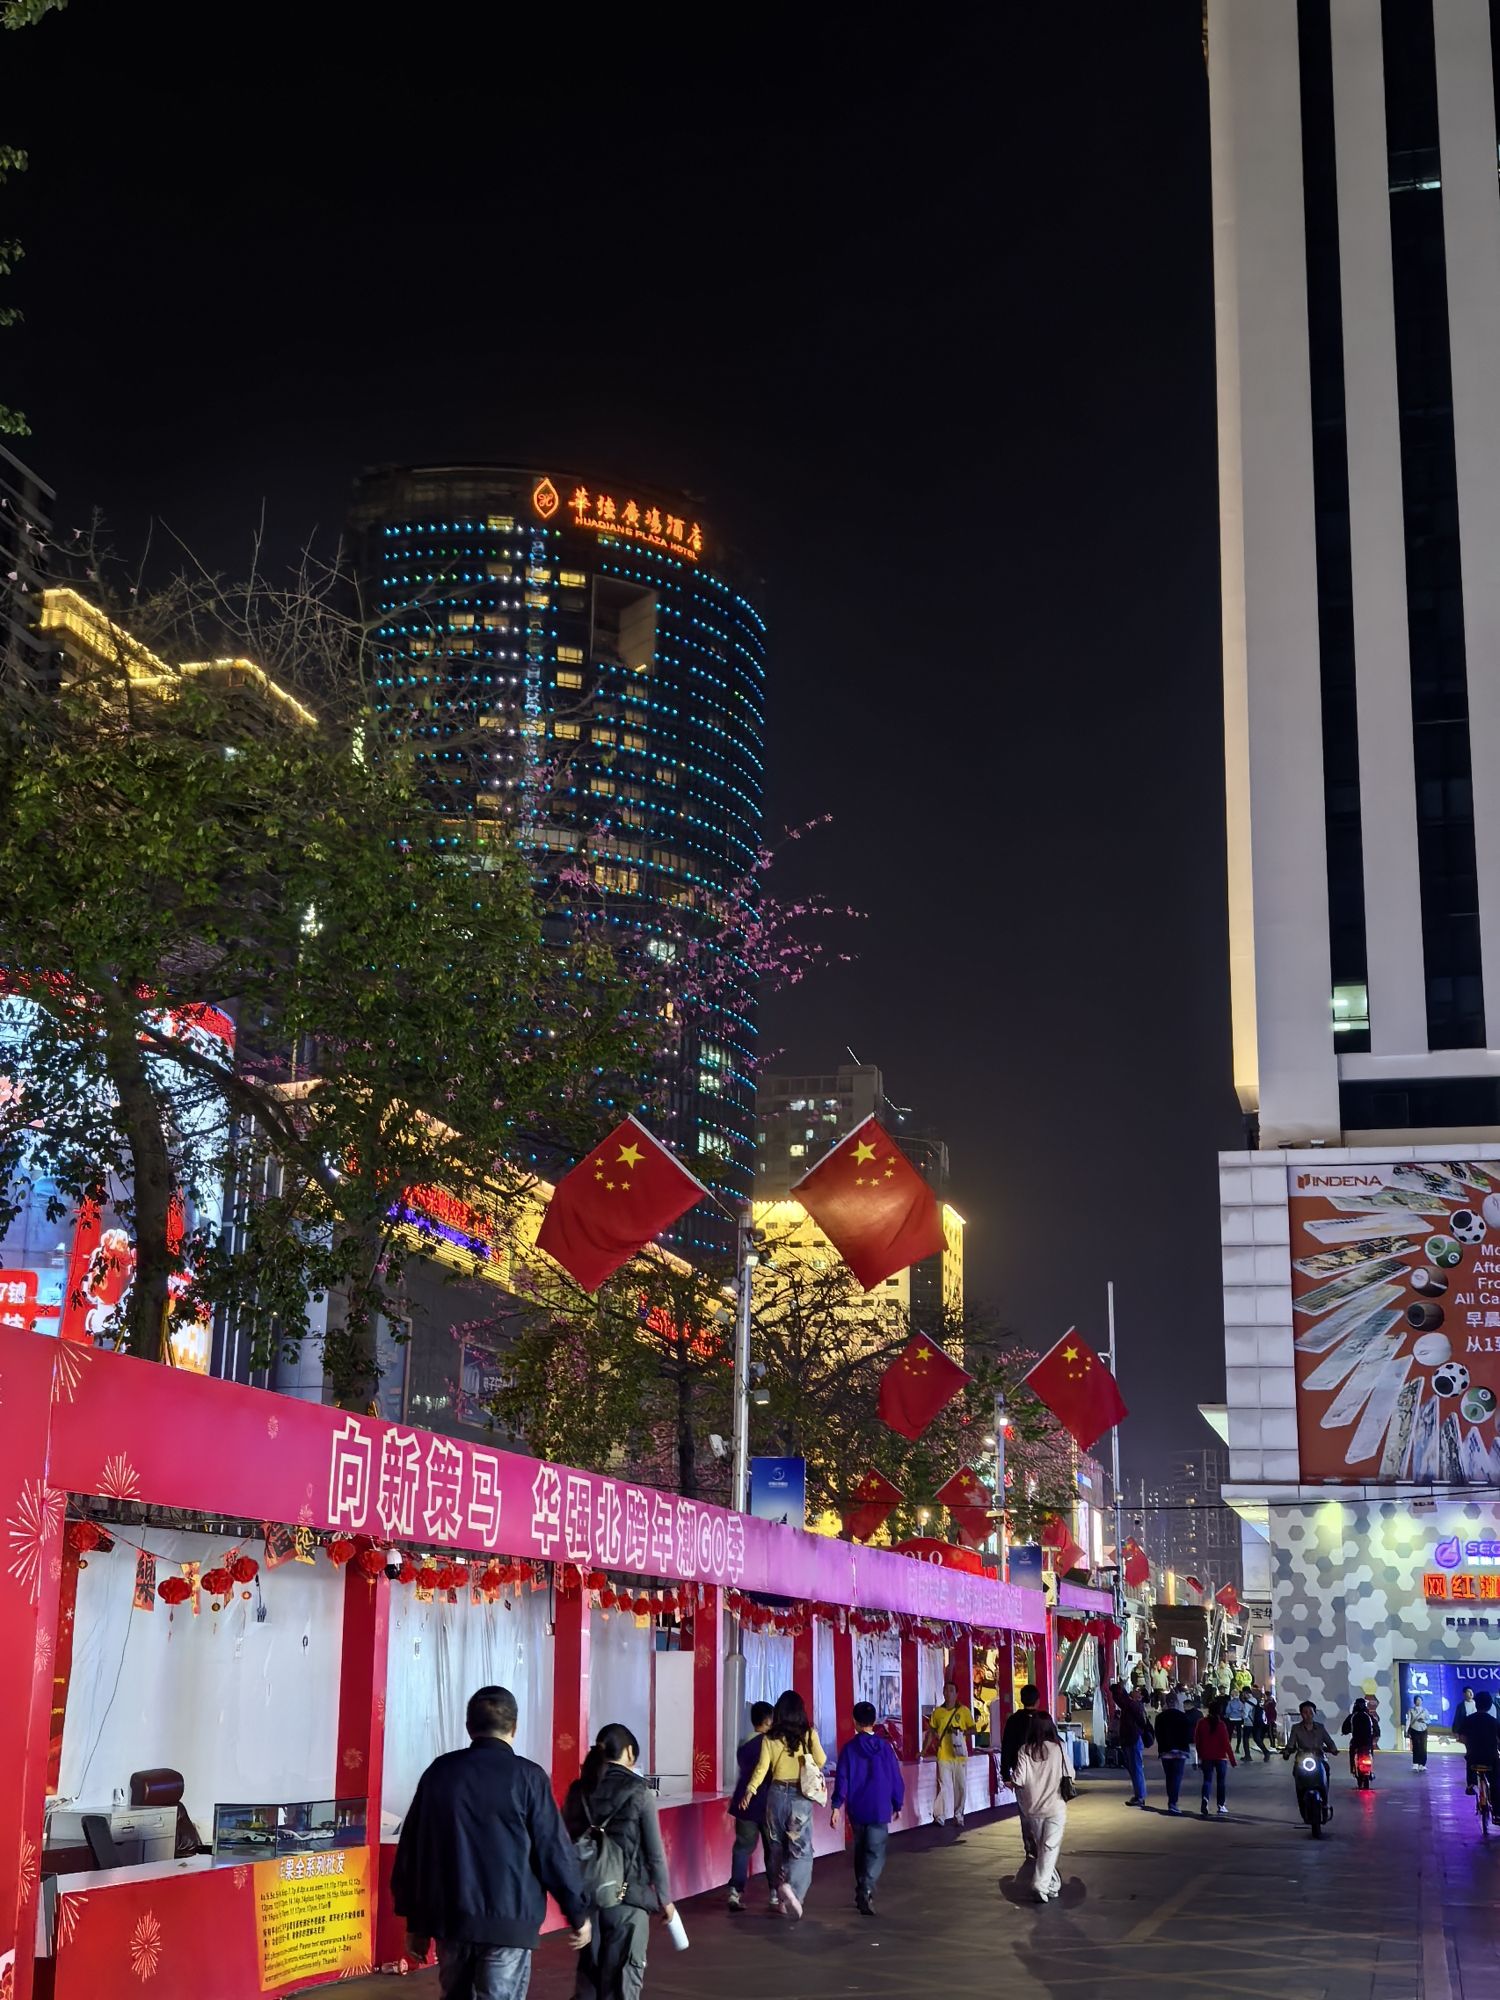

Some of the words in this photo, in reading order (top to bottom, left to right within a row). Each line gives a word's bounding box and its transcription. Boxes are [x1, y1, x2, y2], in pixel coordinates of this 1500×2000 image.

[575, 516, 633, 536] HUAQIANG
[635, 530, 668, 548] PLAZA
[670, 543, 698, 560] HOTEL
[1312, 1175, 1384, 1189] INDENA
[1455, 1293, 1475, 1305] All
[328, 1416, 502, 1548] 向新策马
[531, 1463, 745, 1584] 华强北跨年潮GO季
